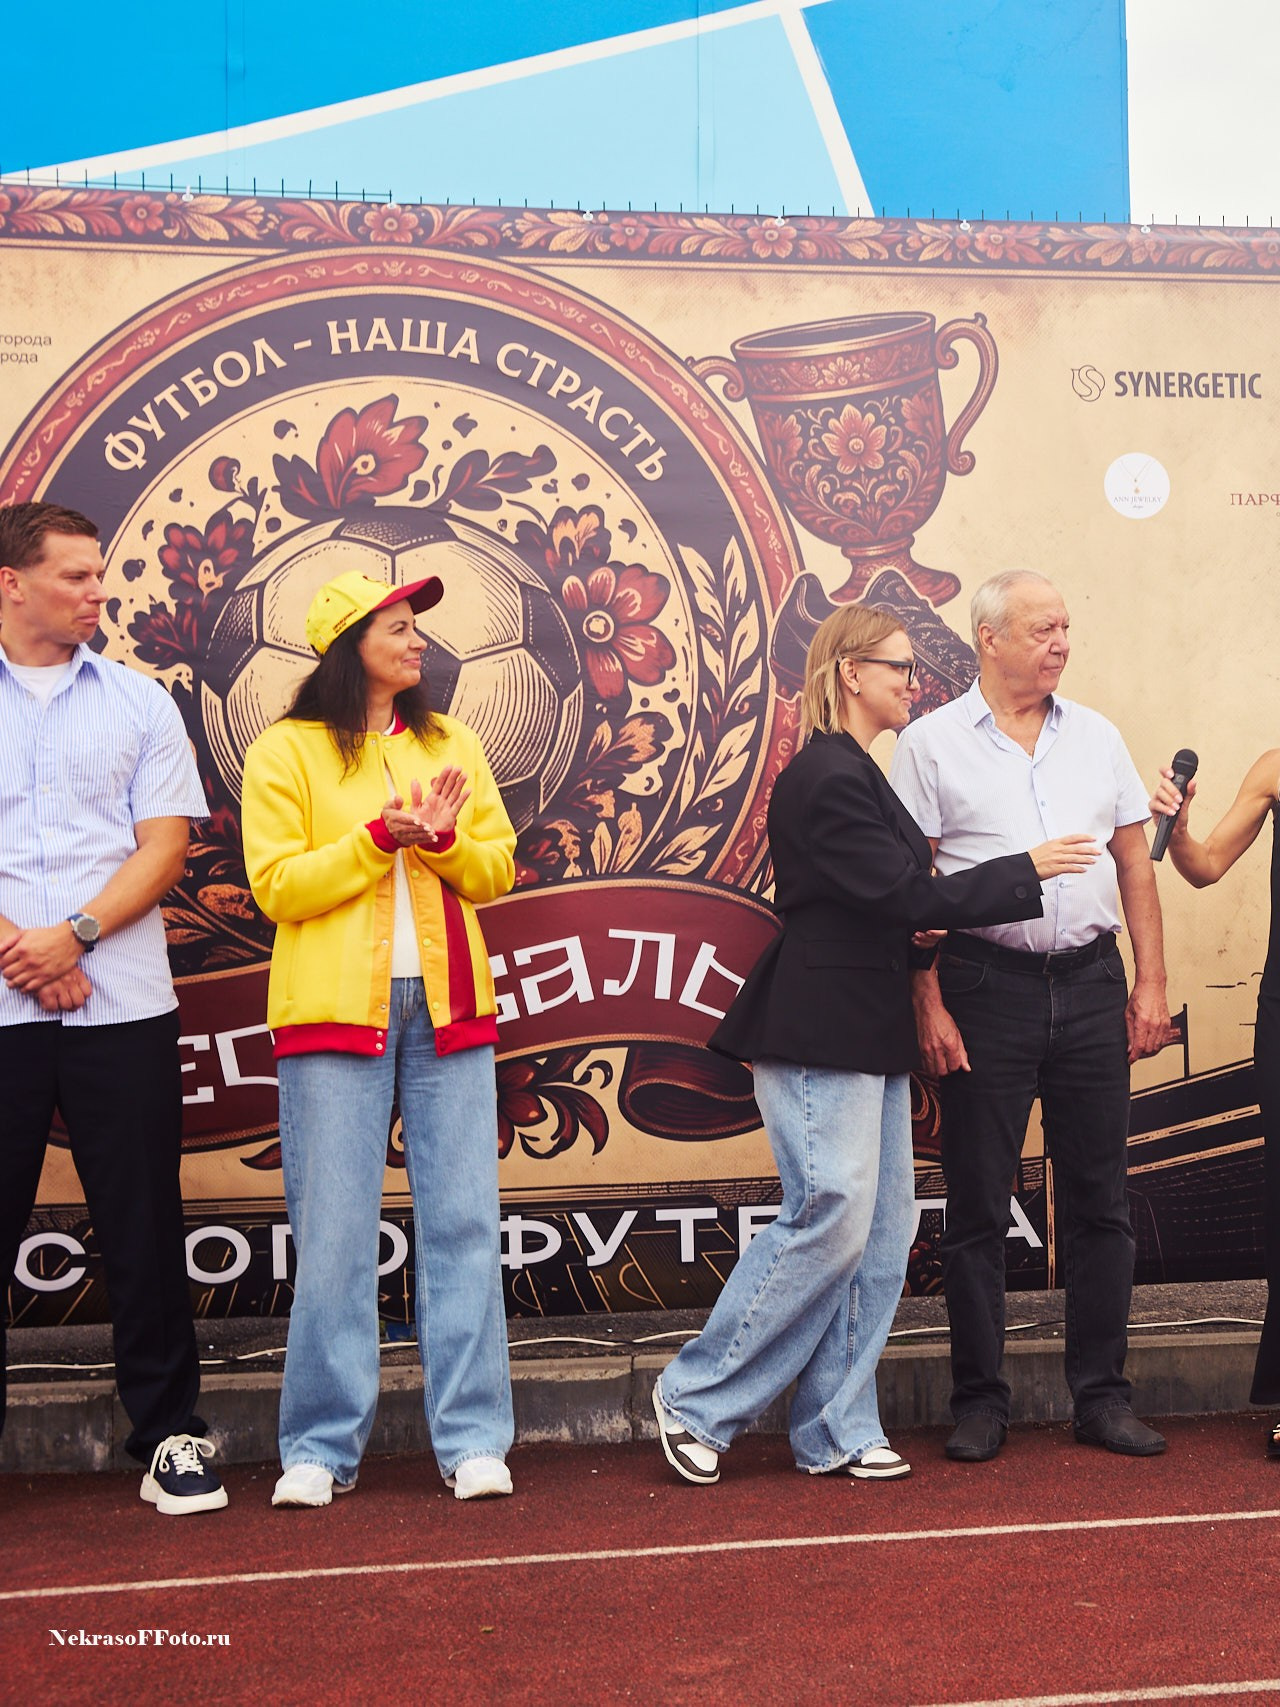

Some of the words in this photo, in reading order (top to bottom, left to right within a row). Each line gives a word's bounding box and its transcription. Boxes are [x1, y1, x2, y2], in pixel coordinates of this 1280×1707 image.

[103, 335, 287, 471] ФУТБОЛ
[326, 317, 481, 364] НАША
[496, 342, 668, 481] СТРАСТЬ
[1114, 371, 1262, 399] SYNERGETIC
